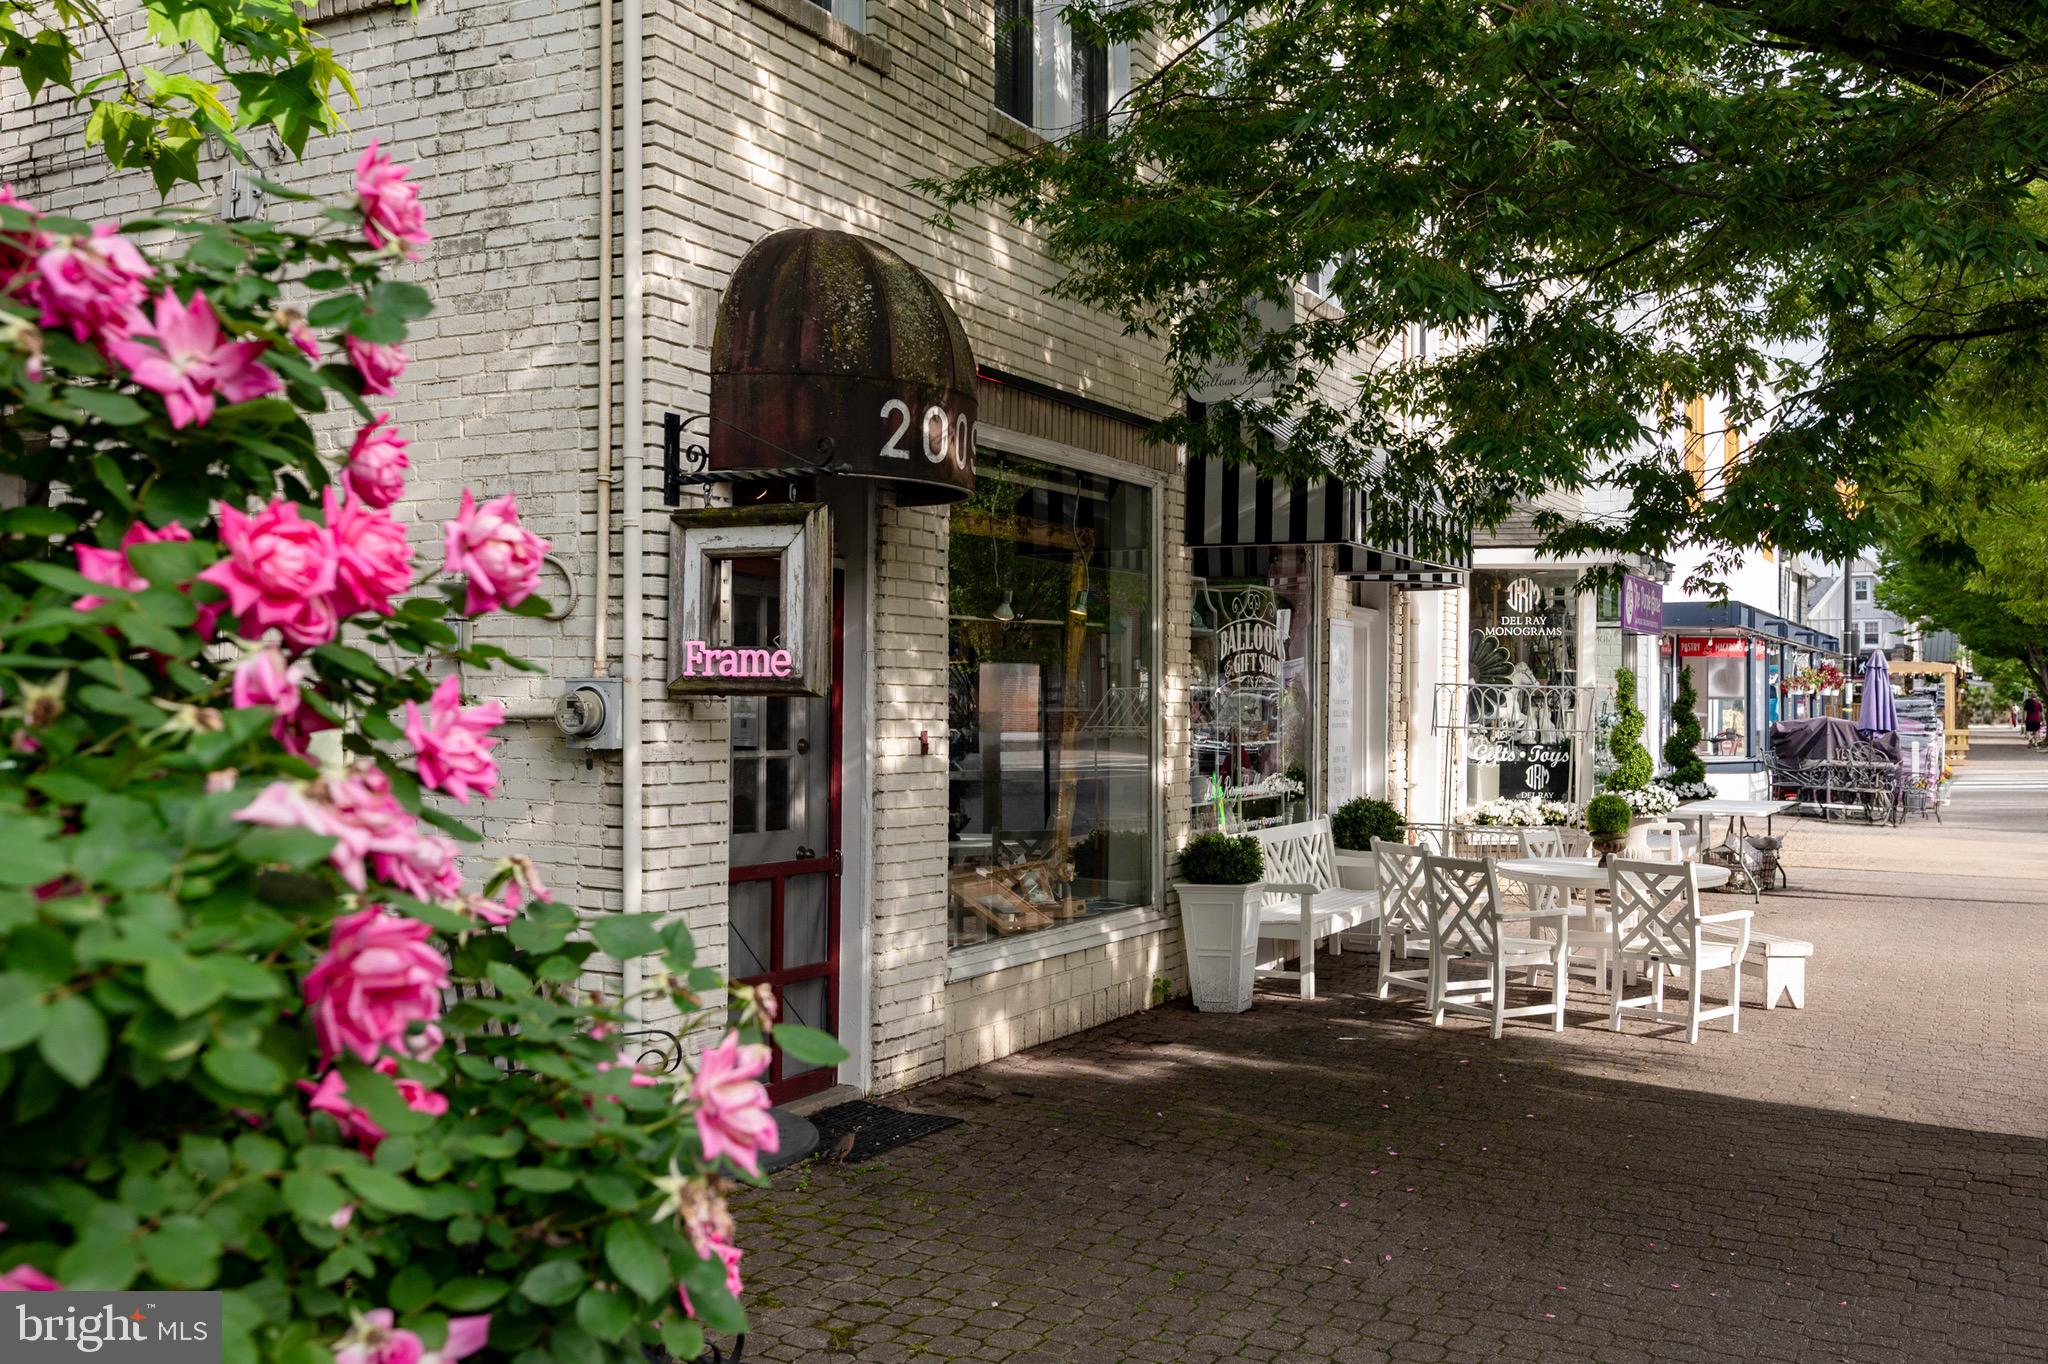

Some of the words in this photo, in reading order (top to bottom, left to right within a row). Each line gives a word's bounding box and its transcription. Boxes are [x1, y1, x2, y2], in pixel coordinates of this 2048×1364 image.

[1501, 616, 1522, 625] DEL
[1525, 616, 1547, 625] RAY
[1485, 626, 1562, 636] MONOGRAMS
[1681, 642, 1701, 652] PASTRY
[683, 640, 792, 679] Frame
[1233, 652, 1257, 674] GIFT
[1474, 744, 1516, 765] Gifts
[1528, 745, 1569, 767] Toys
